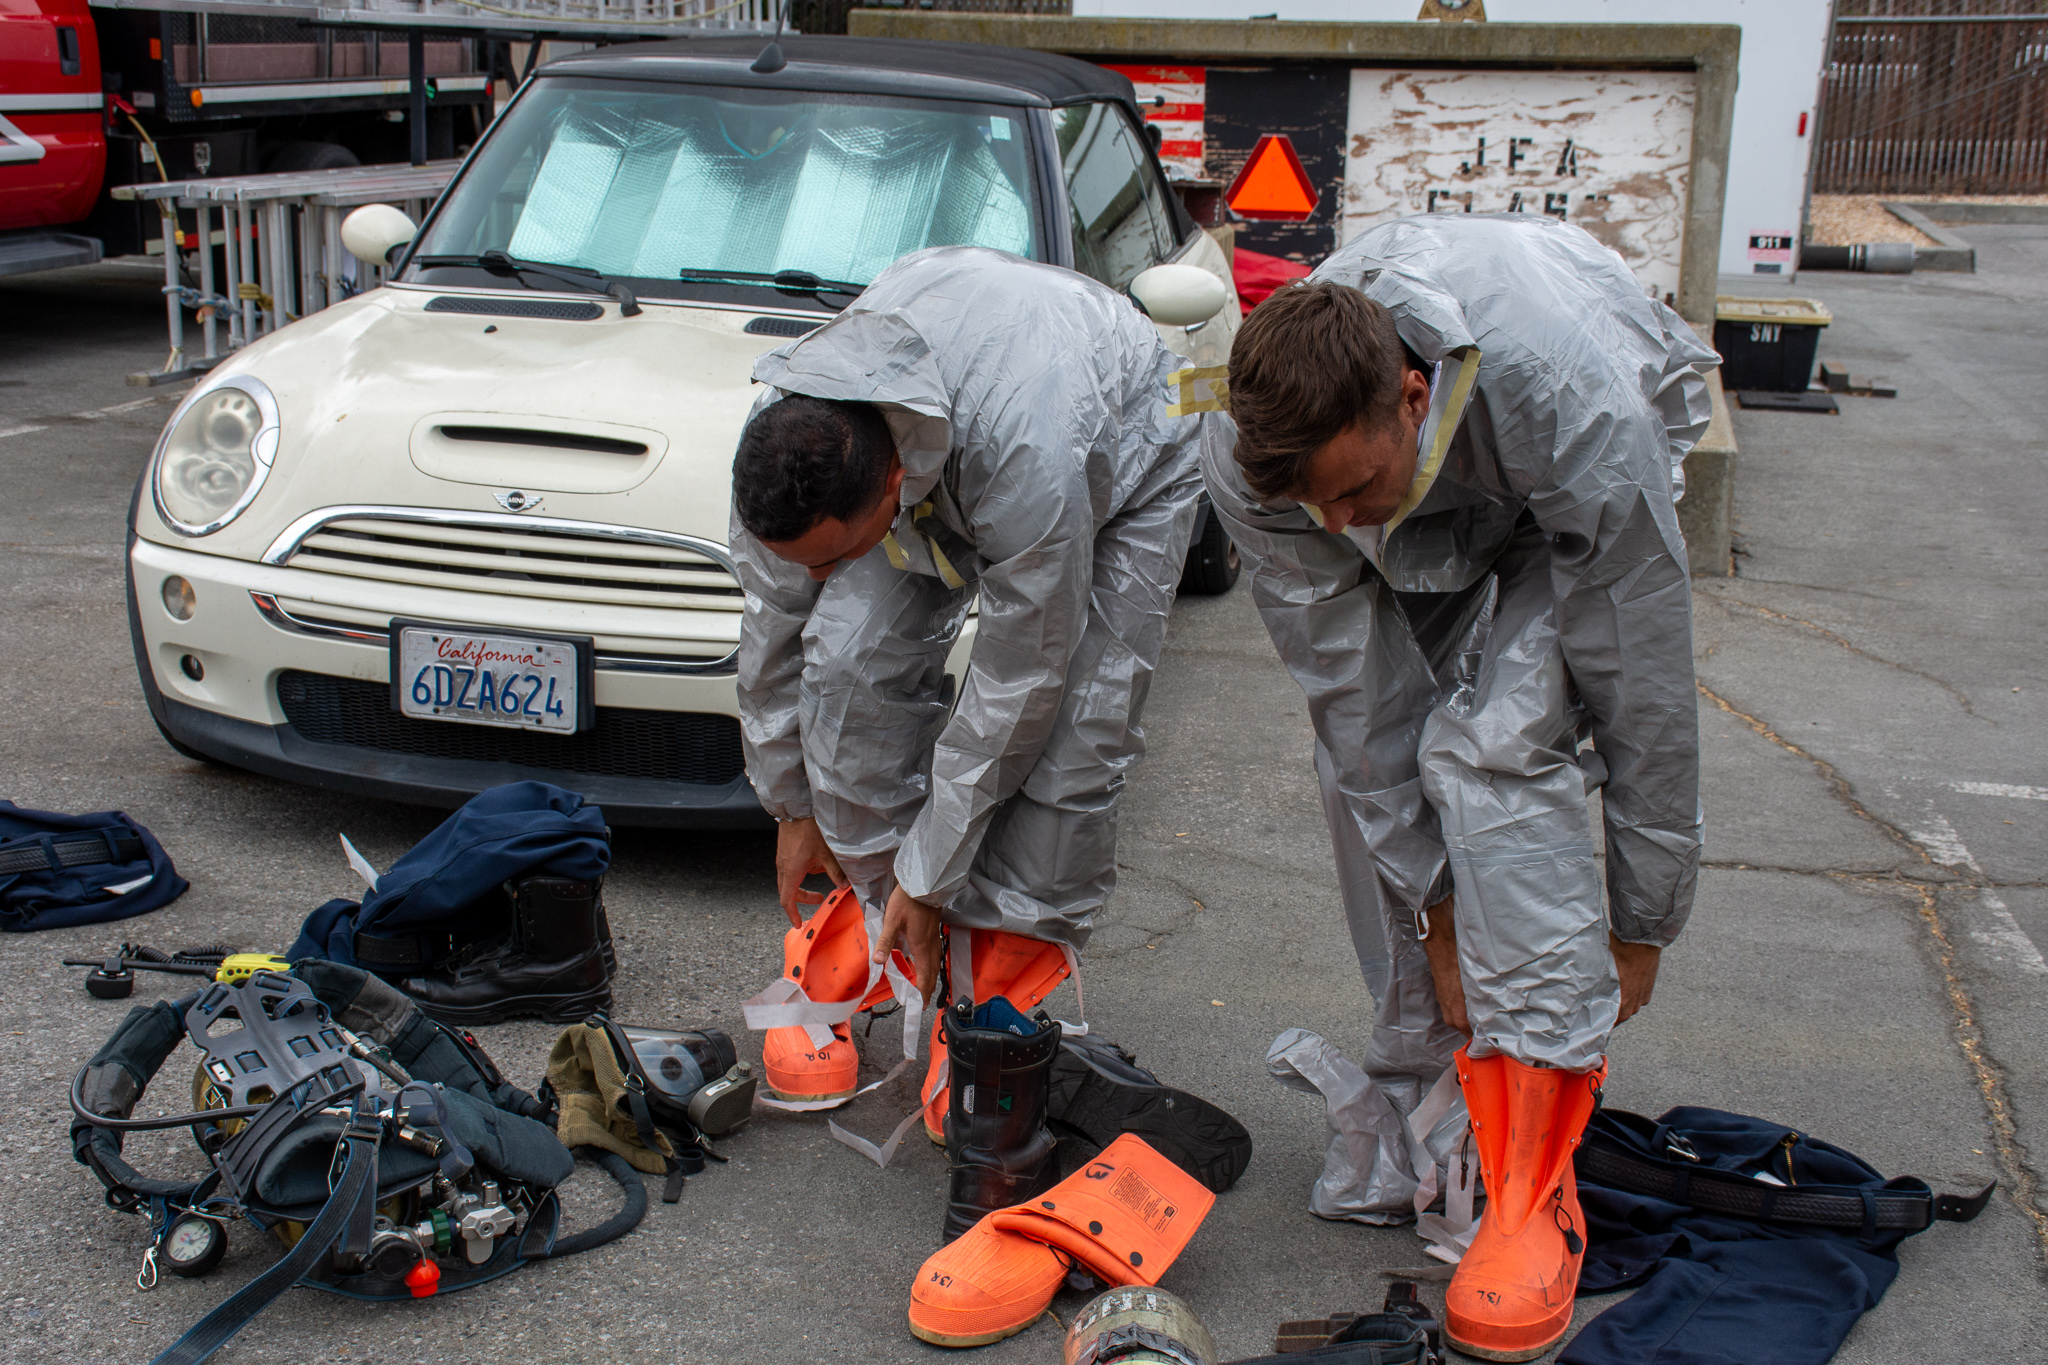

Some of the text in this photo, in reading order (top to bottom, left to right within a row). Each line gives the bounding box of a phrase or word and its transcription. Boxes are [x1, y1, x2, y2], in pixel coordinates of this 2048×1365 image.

[1757, 236, 1781, 249] 911
[508, 496, 525, 504] MINI
[437, 637, 546, 668] California
[411, 664, 564, 718] 6DZA624
[1085, 1162, 1115, 1180] 13
